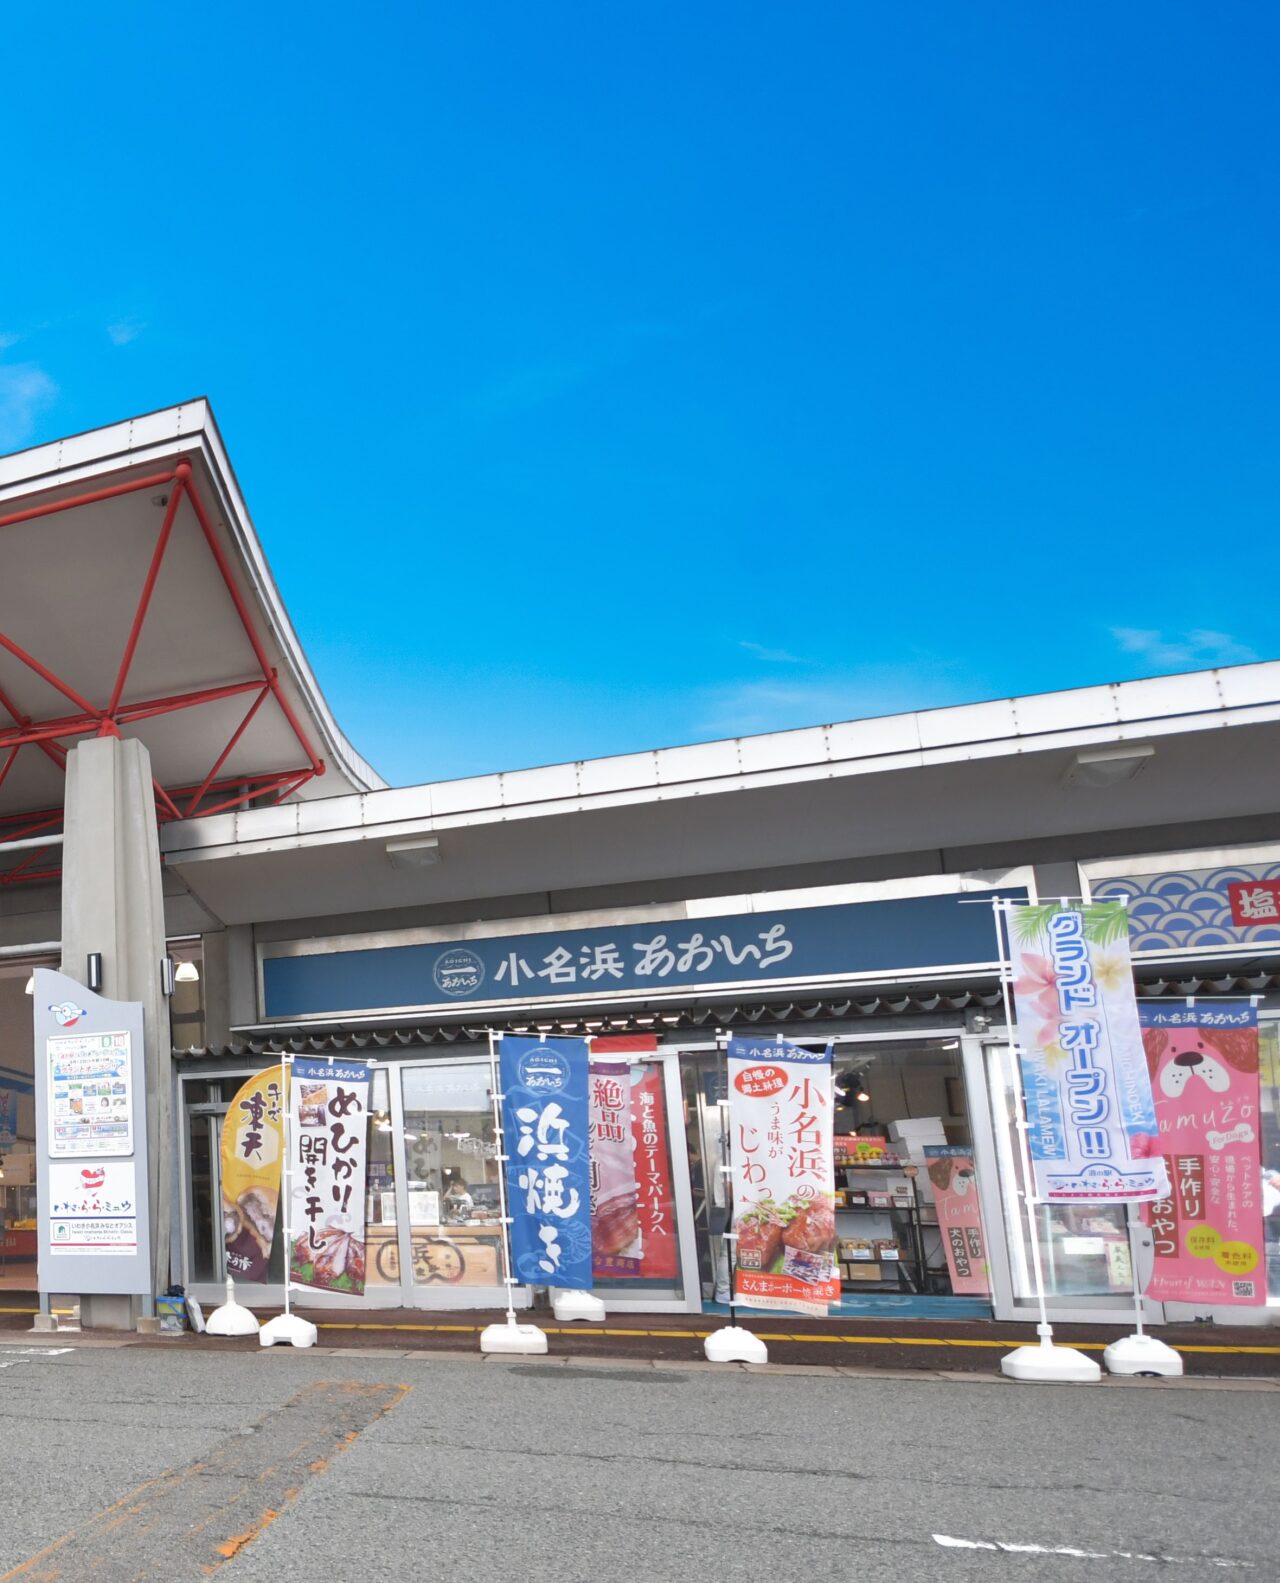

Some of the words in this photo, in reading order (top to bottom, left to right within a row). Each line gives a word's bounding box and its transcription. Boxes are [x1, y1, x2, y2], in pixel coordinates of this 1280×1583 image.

[1239, 888, 1280, 919] 塩
[493, 923, 793, 986] 小名浜あおいち
[1153, 1011, 1250, 1024] 小名浜あおいち
[268, 1083, 282, 1122] チーズ
[307, 1068, 366, 1080] 小名浜あおいち
[742, 1068, 775, 1083] 自慢の
[593, 1078, 625, 1142] 絶品
[768, 1102, 783, 1159] うま味が
[787, 1078, 827, 1198] 小名浜の
[328, 1087, 362, 1212] めひかり
[639, 1092, 667, 1236] 海と魚のテーマパークへ
[739, 1123, 773, 1203] じわっ
[299, 1135, 327, 1249] 開き干し
[516, 1102, 580, 1273] 浜焼き
[1152, 1160, 1176, 1254] おやつ
[1178, 1157, 1202, 1217] 手作り
[950, 1228, 969, 1276] 犬のおやつ
[967, 1228, 981, 1257] 手作り
